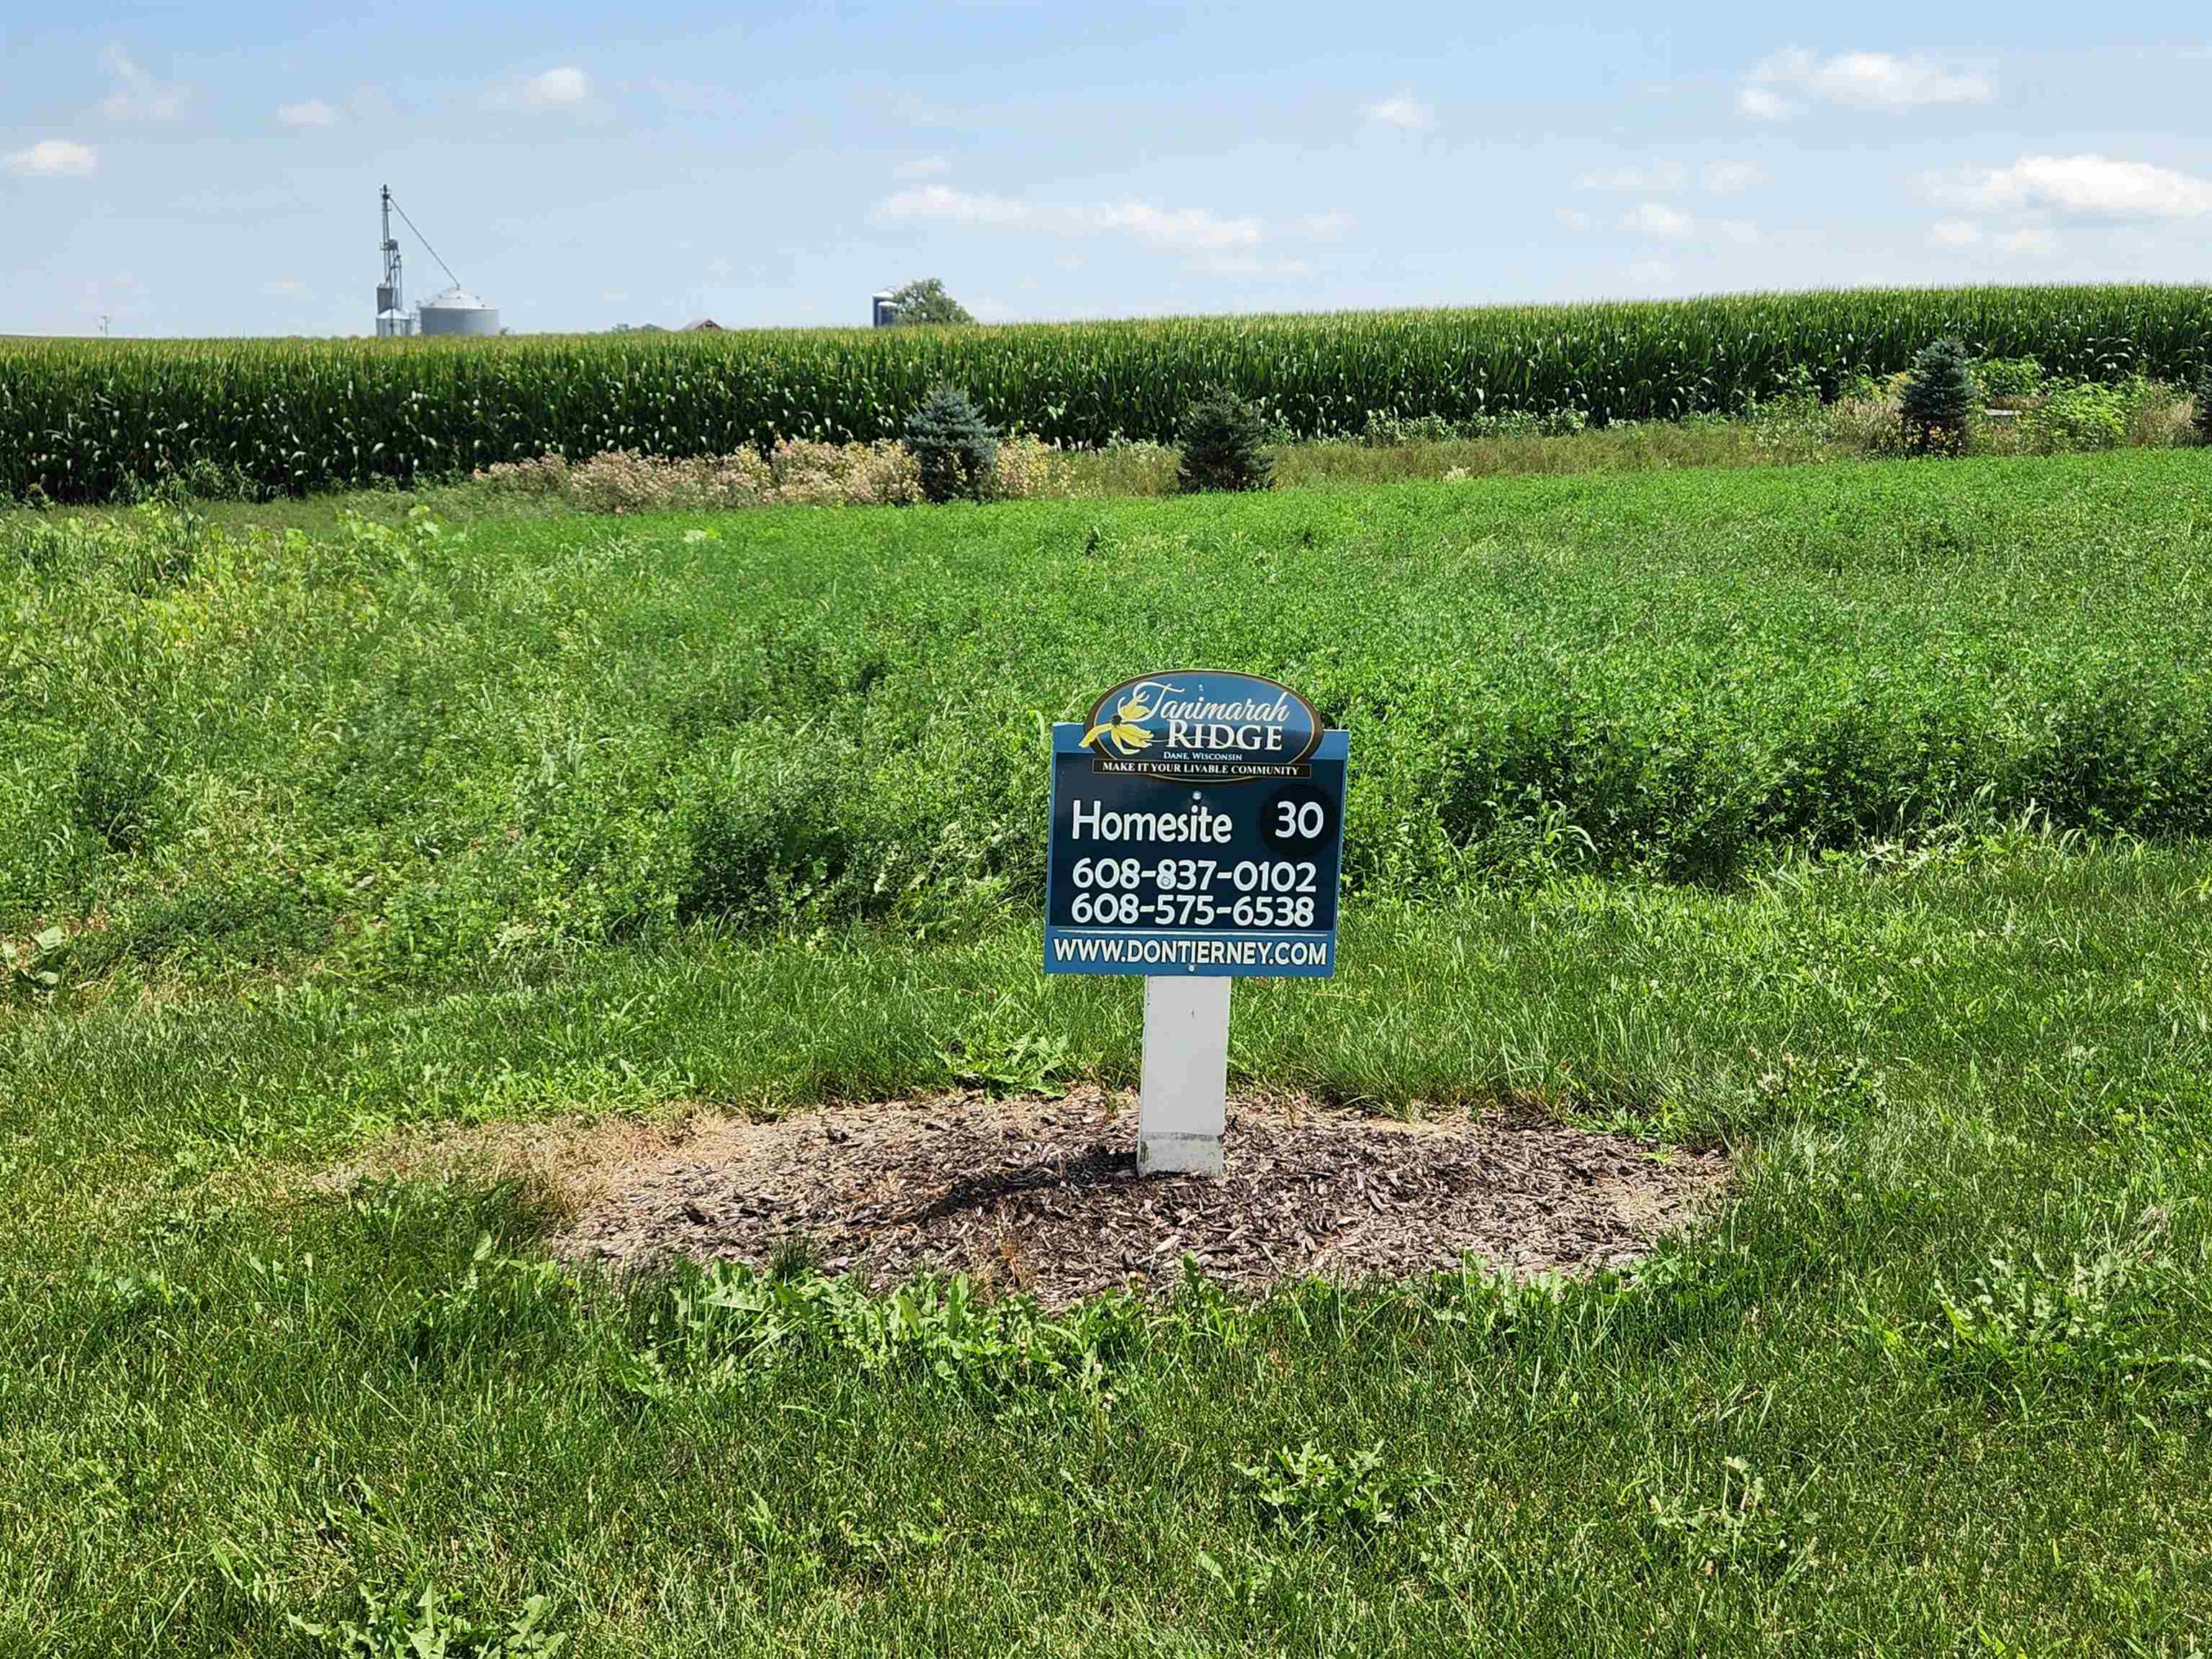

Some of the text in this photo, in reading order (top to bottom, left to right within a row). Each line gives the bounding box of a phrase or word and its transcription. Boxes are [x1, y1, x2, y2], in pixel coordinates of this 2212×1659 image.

[1166, 721, 1283, 750] RIDGE
[1102, 762, 1300, 775] MAKE IT YOUR LIVABLE COMMUNITY
[1164, 752, 1243, 761] DANE, WISCONSIN
[1072, 800, 1324, 843] Homesite 30
[1072, 858, 1317, 893] 608-837-0102
[1071, 893, 1315, 927] 608-575-6538
[1053, 938, 1327, 966] WWW.DONTIERNEY.COM
